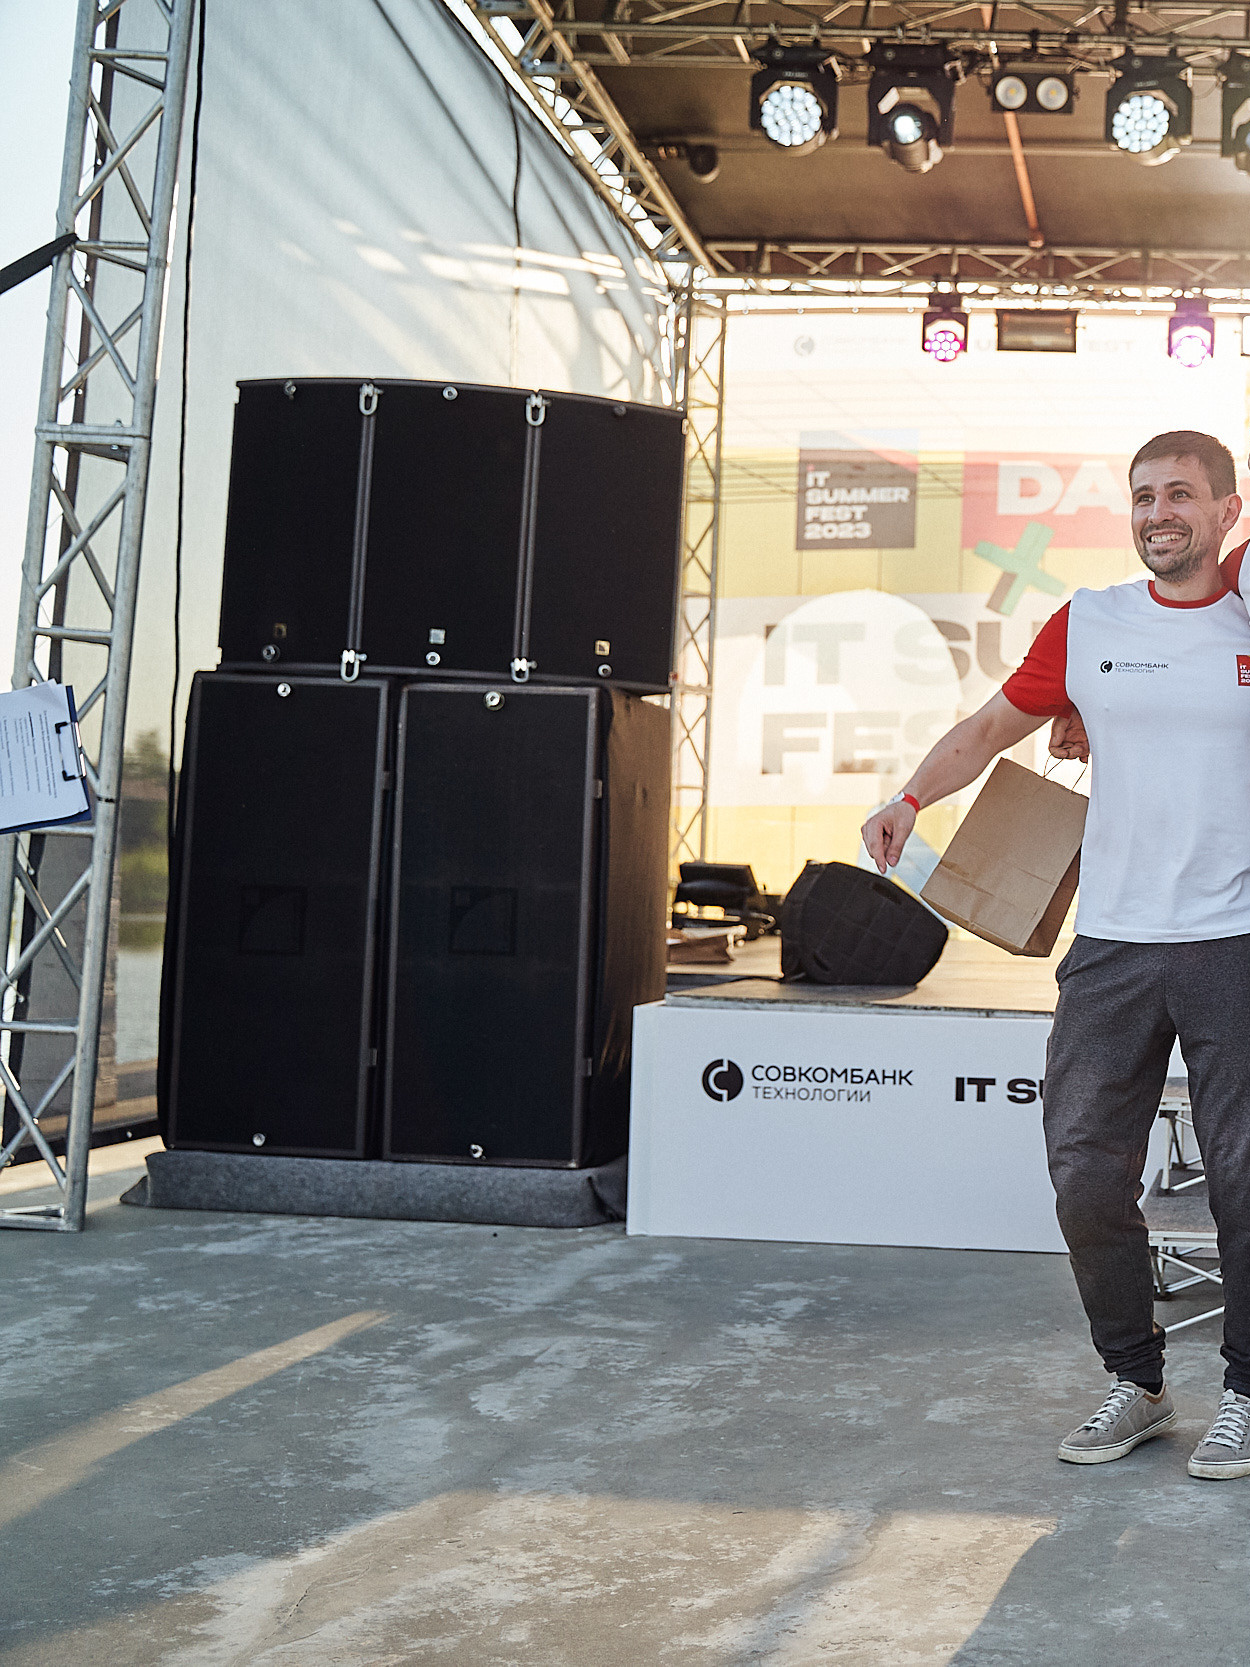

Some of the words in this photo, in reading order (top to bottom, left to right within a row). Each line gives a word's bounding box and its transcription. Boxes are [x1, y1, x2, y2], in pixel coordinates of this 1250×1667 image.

[805, 470, 831, 488] IT
[805, 487, 910, 504] SUMMER
[805, 504, 868, 522] FEST
[804, 522, 872, 540] 2023
[763, 621, 866, 686] IT
[1115, 661, 1169, 669] СОВКОМБАНК
[751, 1064, 914, 1086] СОВКОМБАНК
[752, 1086, 871, 1102] ТЕХНОЛОГИИ
[955, 1077, 996, 1102] IT
